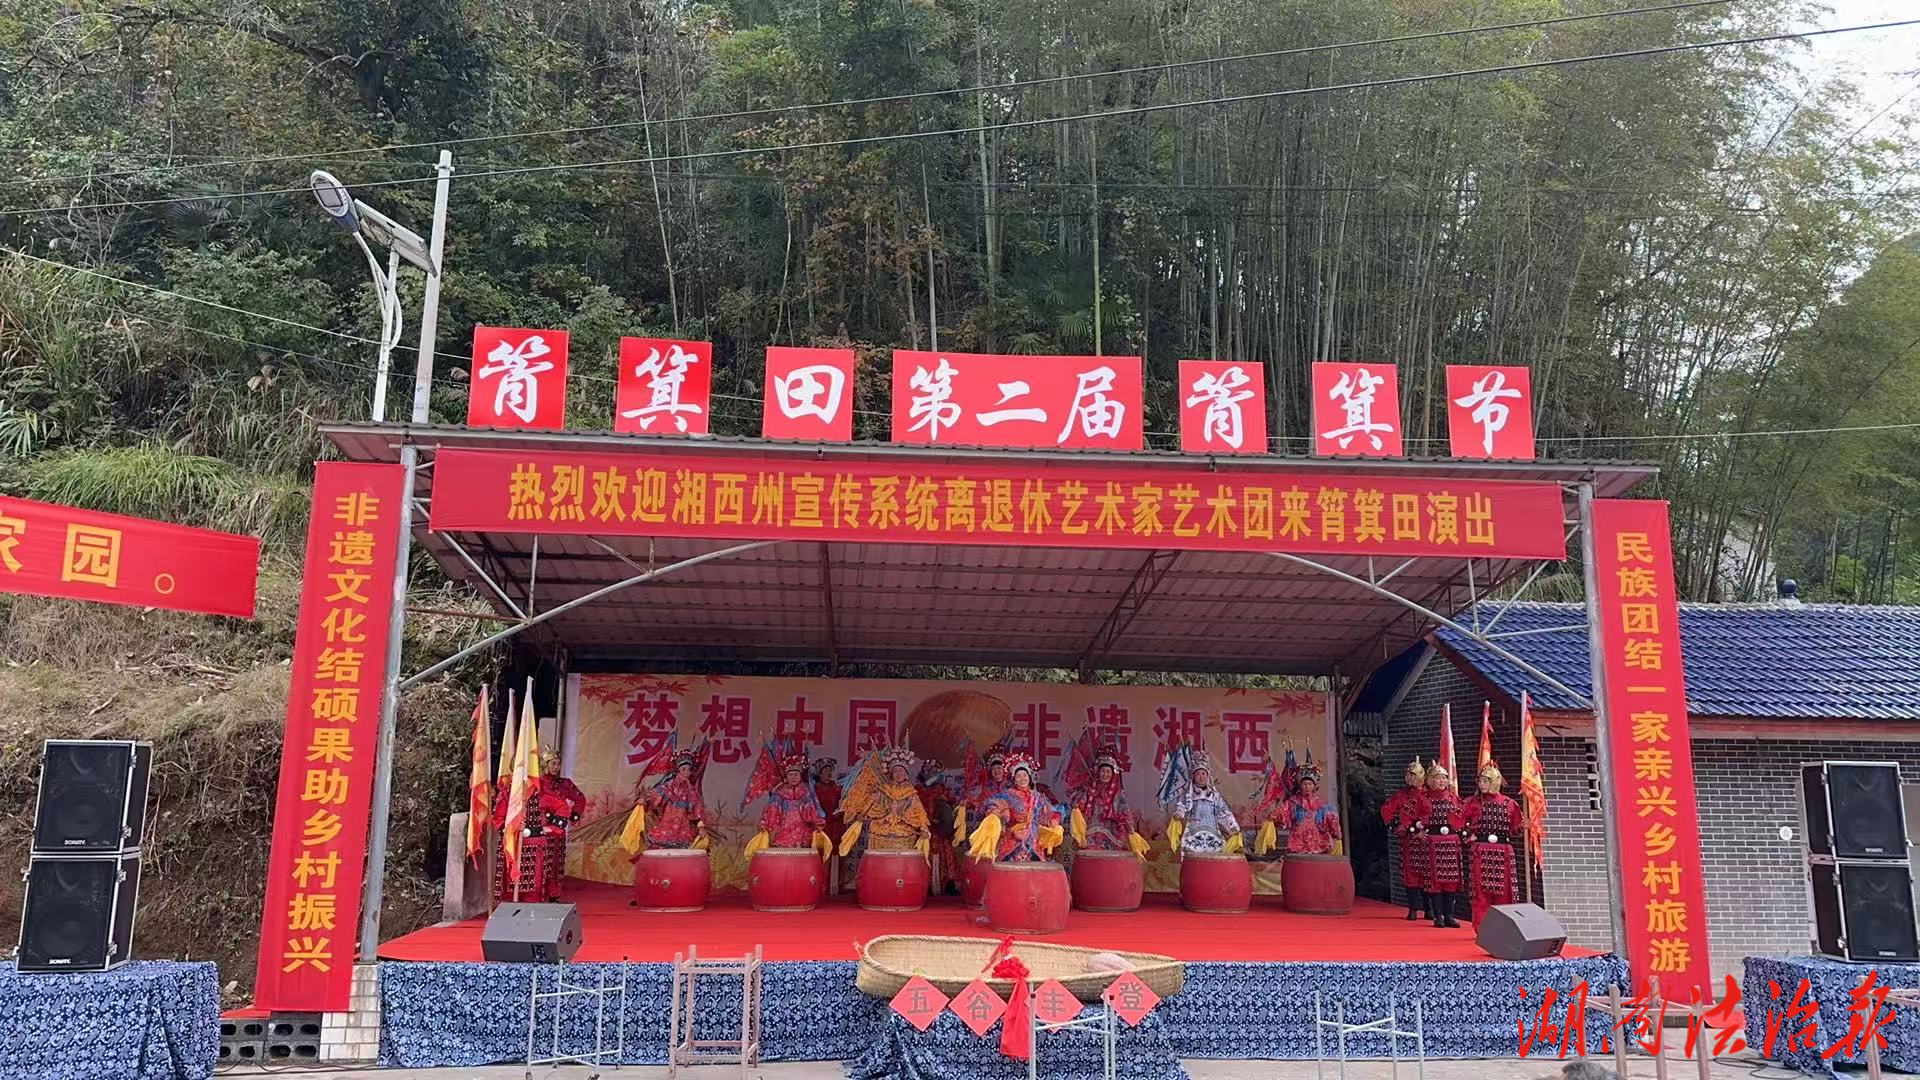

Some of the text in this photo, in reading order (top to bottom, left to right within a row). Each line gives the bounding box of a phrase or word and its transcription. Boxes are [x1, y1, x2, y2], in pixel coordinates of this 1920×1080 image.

[508, 463, 1495, 545] 热烈欢迎湘西州宣传系统离退休艺术家艺术团来筲箕田演出
[283, 492, 380, 973] 非遗文化结硕果助乡村振兴
[624, 693, 1273, 774] 梦想中国 非遗湘西
[1616, 532, 1692, 973] 民族团结一家亲兴乡村旅游
[906, 981, 1144, 1022] 五谷丰登
